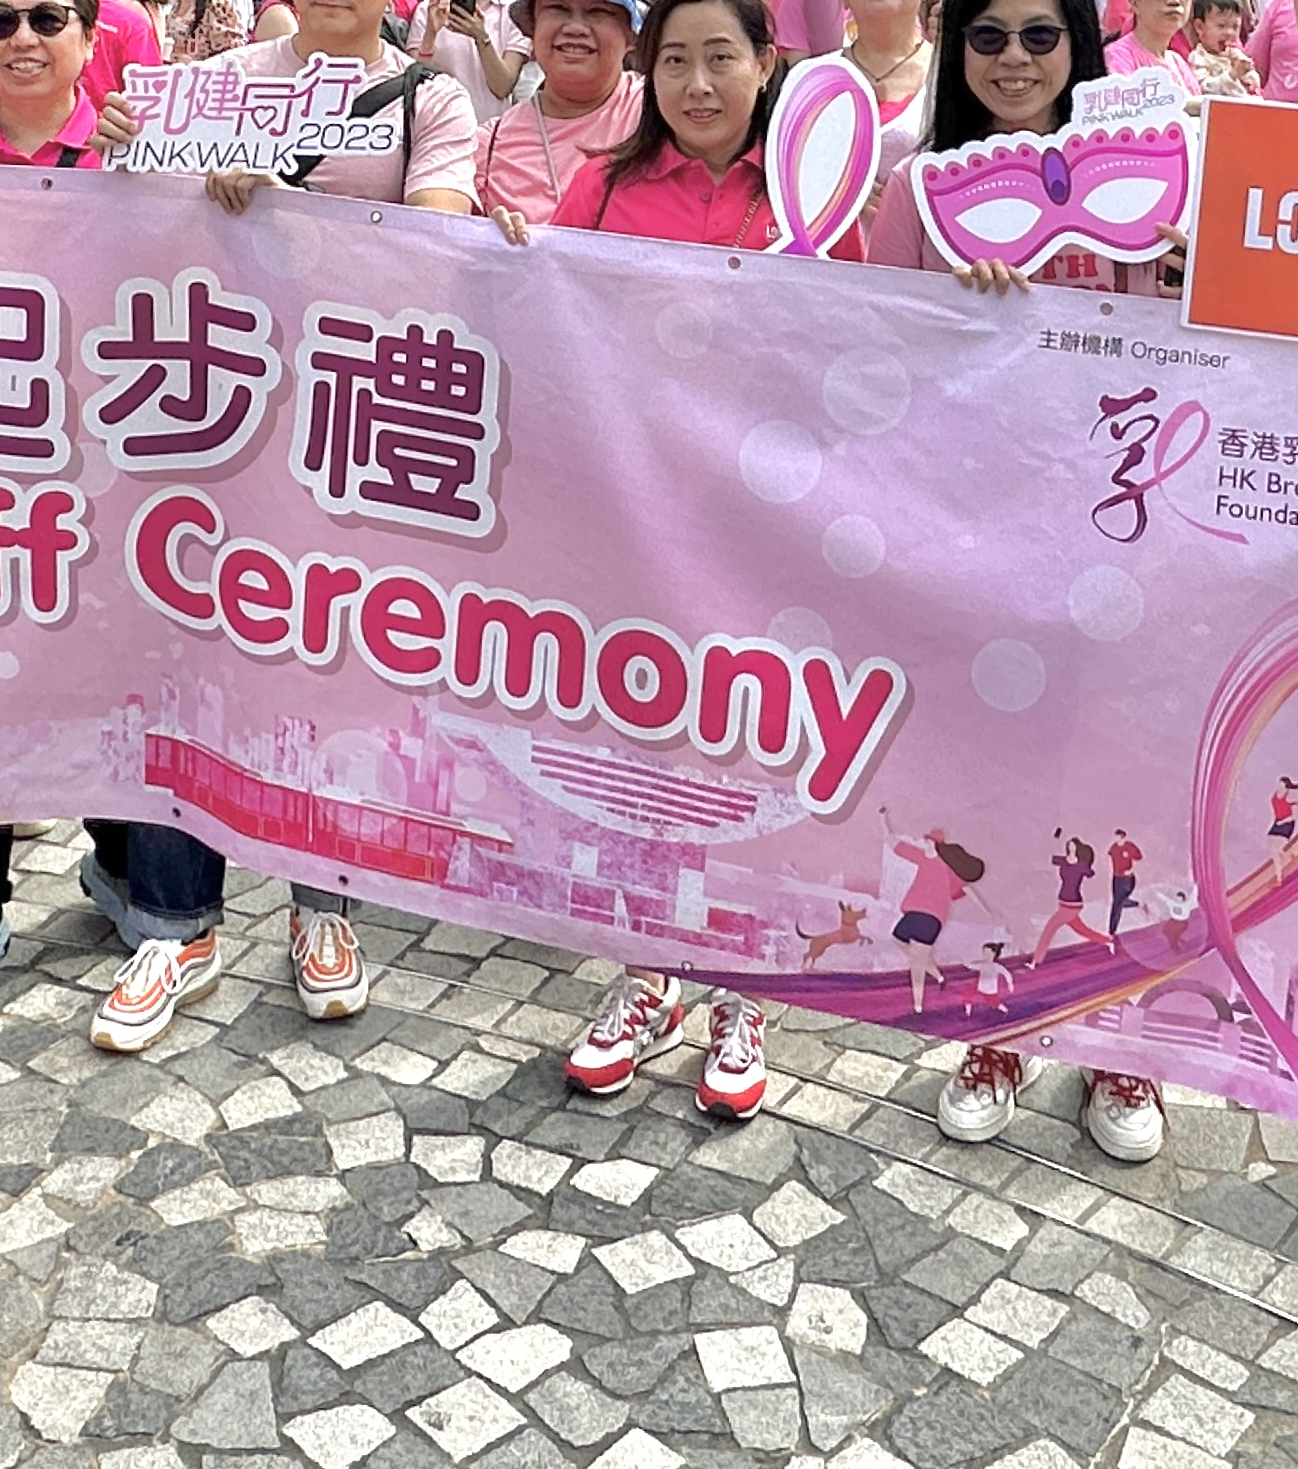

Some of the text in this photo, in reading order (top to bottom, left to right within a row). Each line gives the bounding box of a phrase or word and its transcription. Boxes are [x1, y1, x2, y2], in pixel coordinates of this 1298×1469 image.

[129, 57, 363, 138] 乳健同行
[106, 122, 394, 170] PINK WALK 2023
[1038, 330, 1231, 371] 主辦機構 Organiser
[1217, 465, 1257, 492] HK
[135, 494, 896, 804] Ceremony
